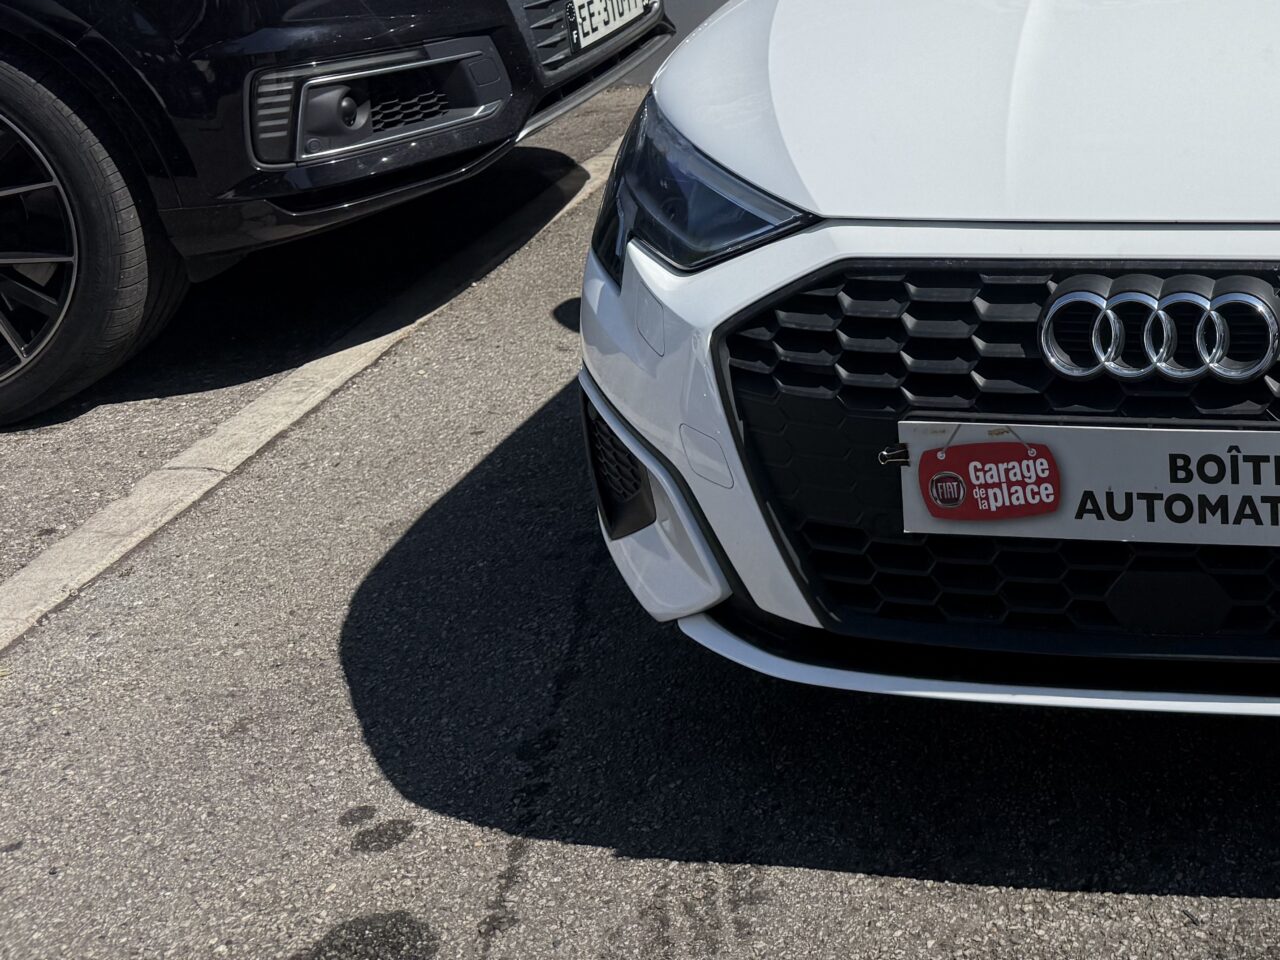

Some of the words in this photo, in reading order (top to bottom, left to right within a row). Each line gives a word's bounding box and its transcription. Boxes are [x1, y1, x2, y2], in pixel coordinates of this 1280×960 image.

[968, 458, 1050, 485] Garage
[937, 481, 959, 500] FIAT
[973, 486, 987, 499] de
[987, 482, 1055, 512] place
[978, 500, 989, 510] la
